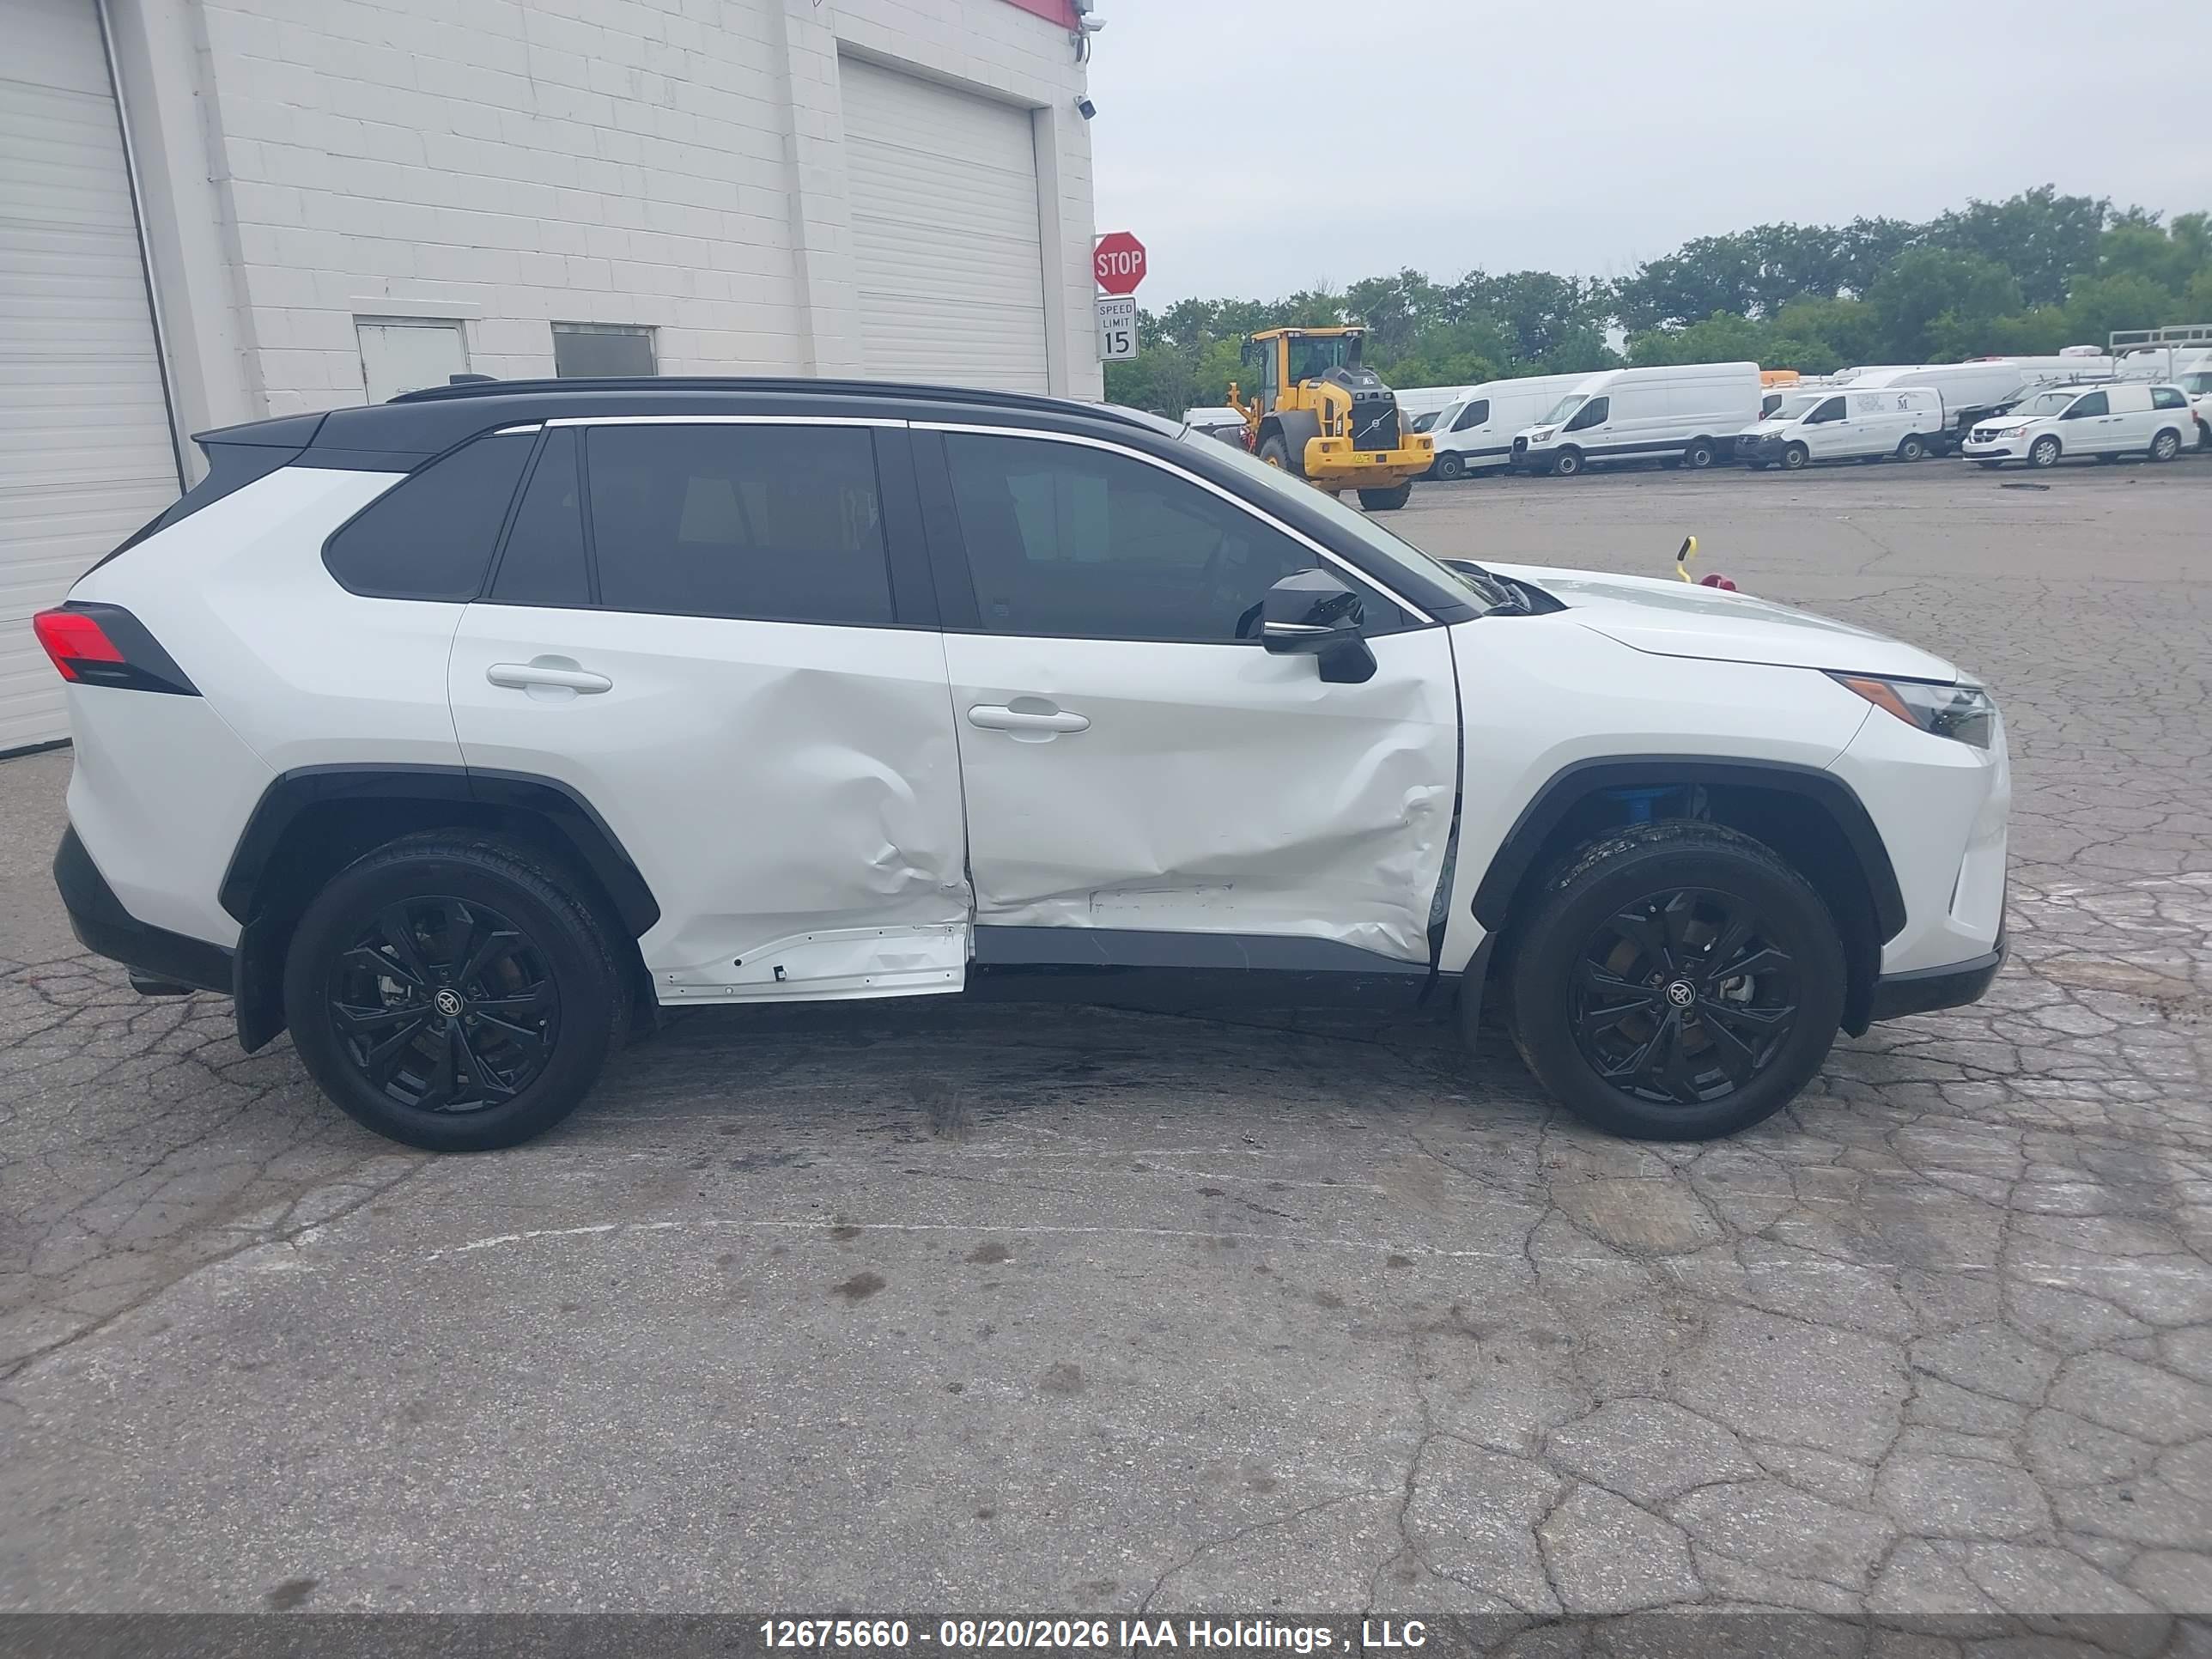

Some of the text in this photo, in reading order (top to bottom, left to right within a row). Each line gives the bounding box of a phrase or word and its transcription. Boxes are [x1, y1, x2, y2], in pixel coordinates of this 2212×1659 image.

[1097, 251, 1142, 276] STOP
[1099, 304, 1133, 315] SPEED
[1103, 317, 1129, 328] LIMIT
[1104, 331, 1129, 354] 15
[1898, 399, 1908, 410] M
